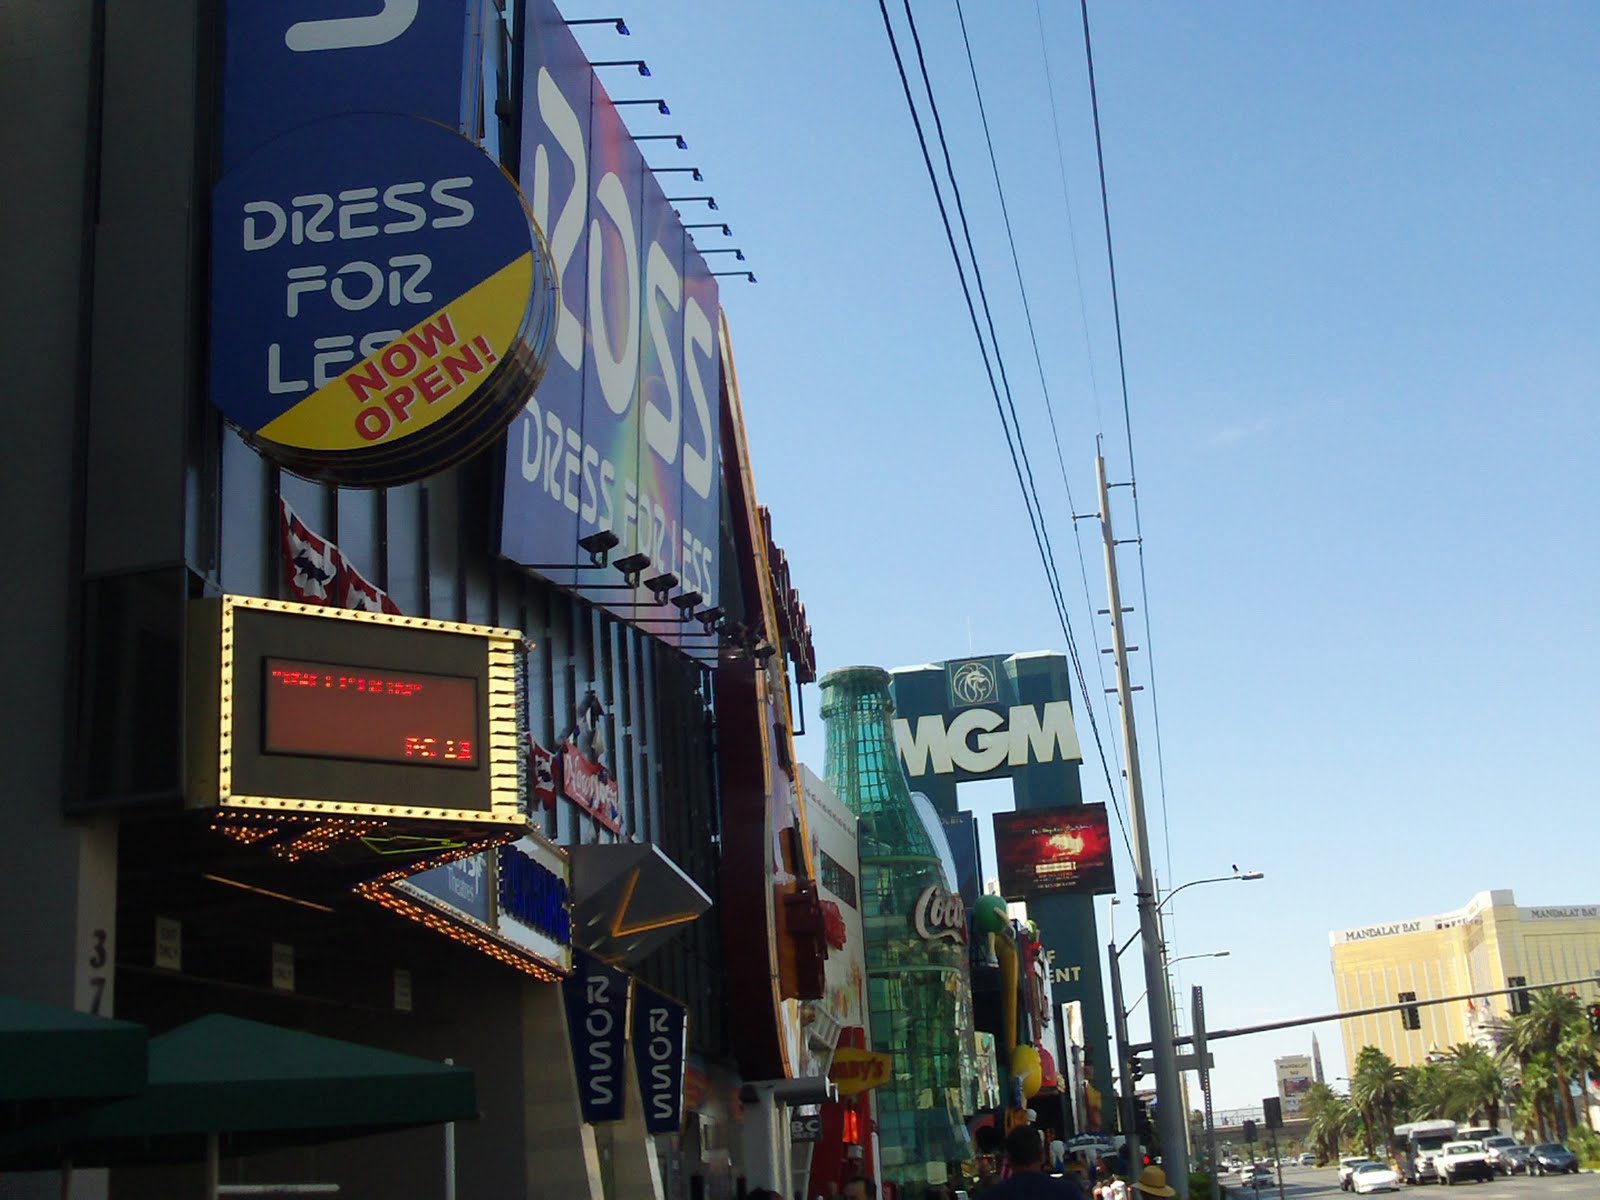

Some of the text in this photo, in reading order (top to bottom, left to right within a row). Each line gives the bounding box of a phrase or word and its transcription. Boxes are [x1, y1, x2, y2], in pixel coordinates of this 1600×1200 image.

[243, 176, 474, 252] DRESS
[286, 253, 433, 318] FOR
[533, 66, 713, 500] ROSS
[344, 313, 456, 403] NOW
[354, 335, 498, 442] OPEN!
[521, 396, 712, 608] DRESS FOR LESS
[893, 700, 1081, 777] MGM
[915, 885, 967, 944] Coca
[1345, 921, 1421, 941] MANDALAY BAY
[1531, 907, 1598, 918] MANDALAY BAY
[585, 975, 613, 1105] ROSS
[648, 1007, 673, 1119] ROSS
[791, 1120, 819, 1132] BC
